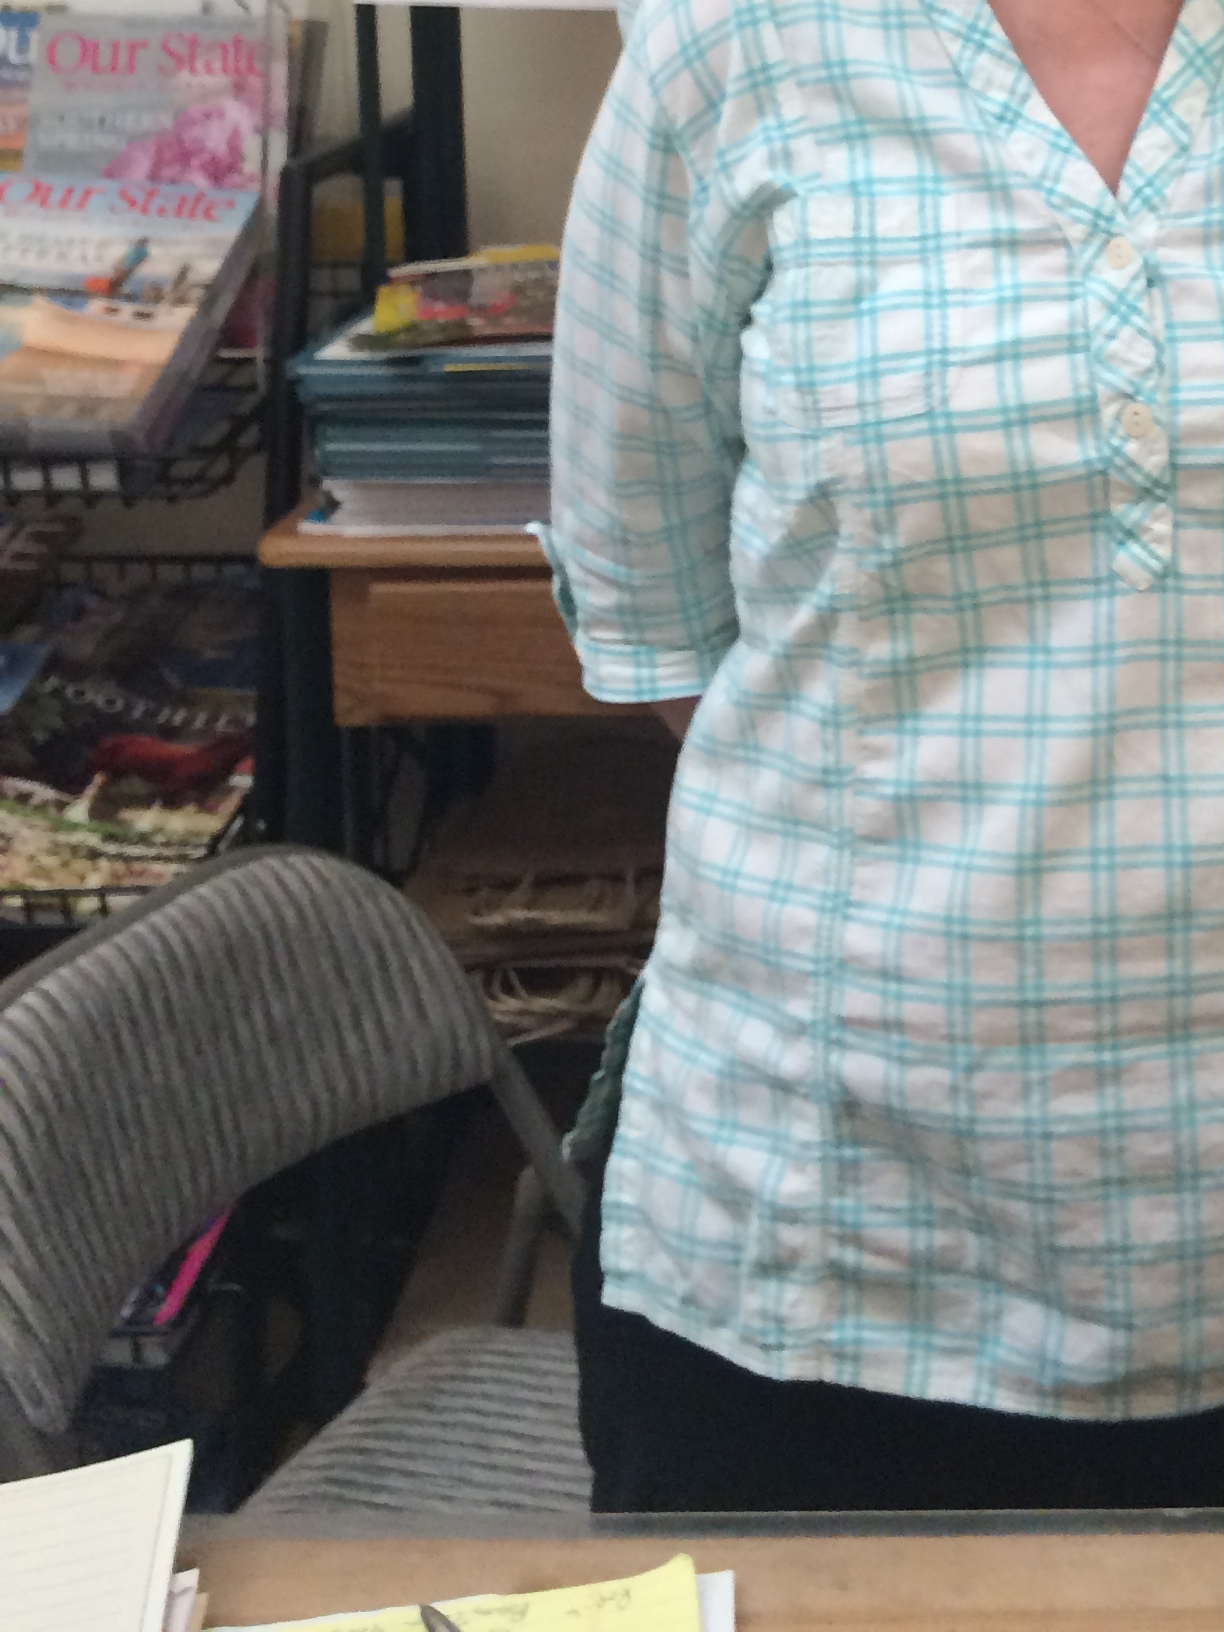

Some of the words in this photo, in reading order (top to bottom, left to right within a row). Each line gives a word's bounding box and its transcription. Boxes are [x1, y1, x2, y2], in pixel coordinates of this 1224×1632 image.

[45, 31, 149, 76] Our
[0, 178, 106, 210] Our
[110, 186, 237, 224] State
